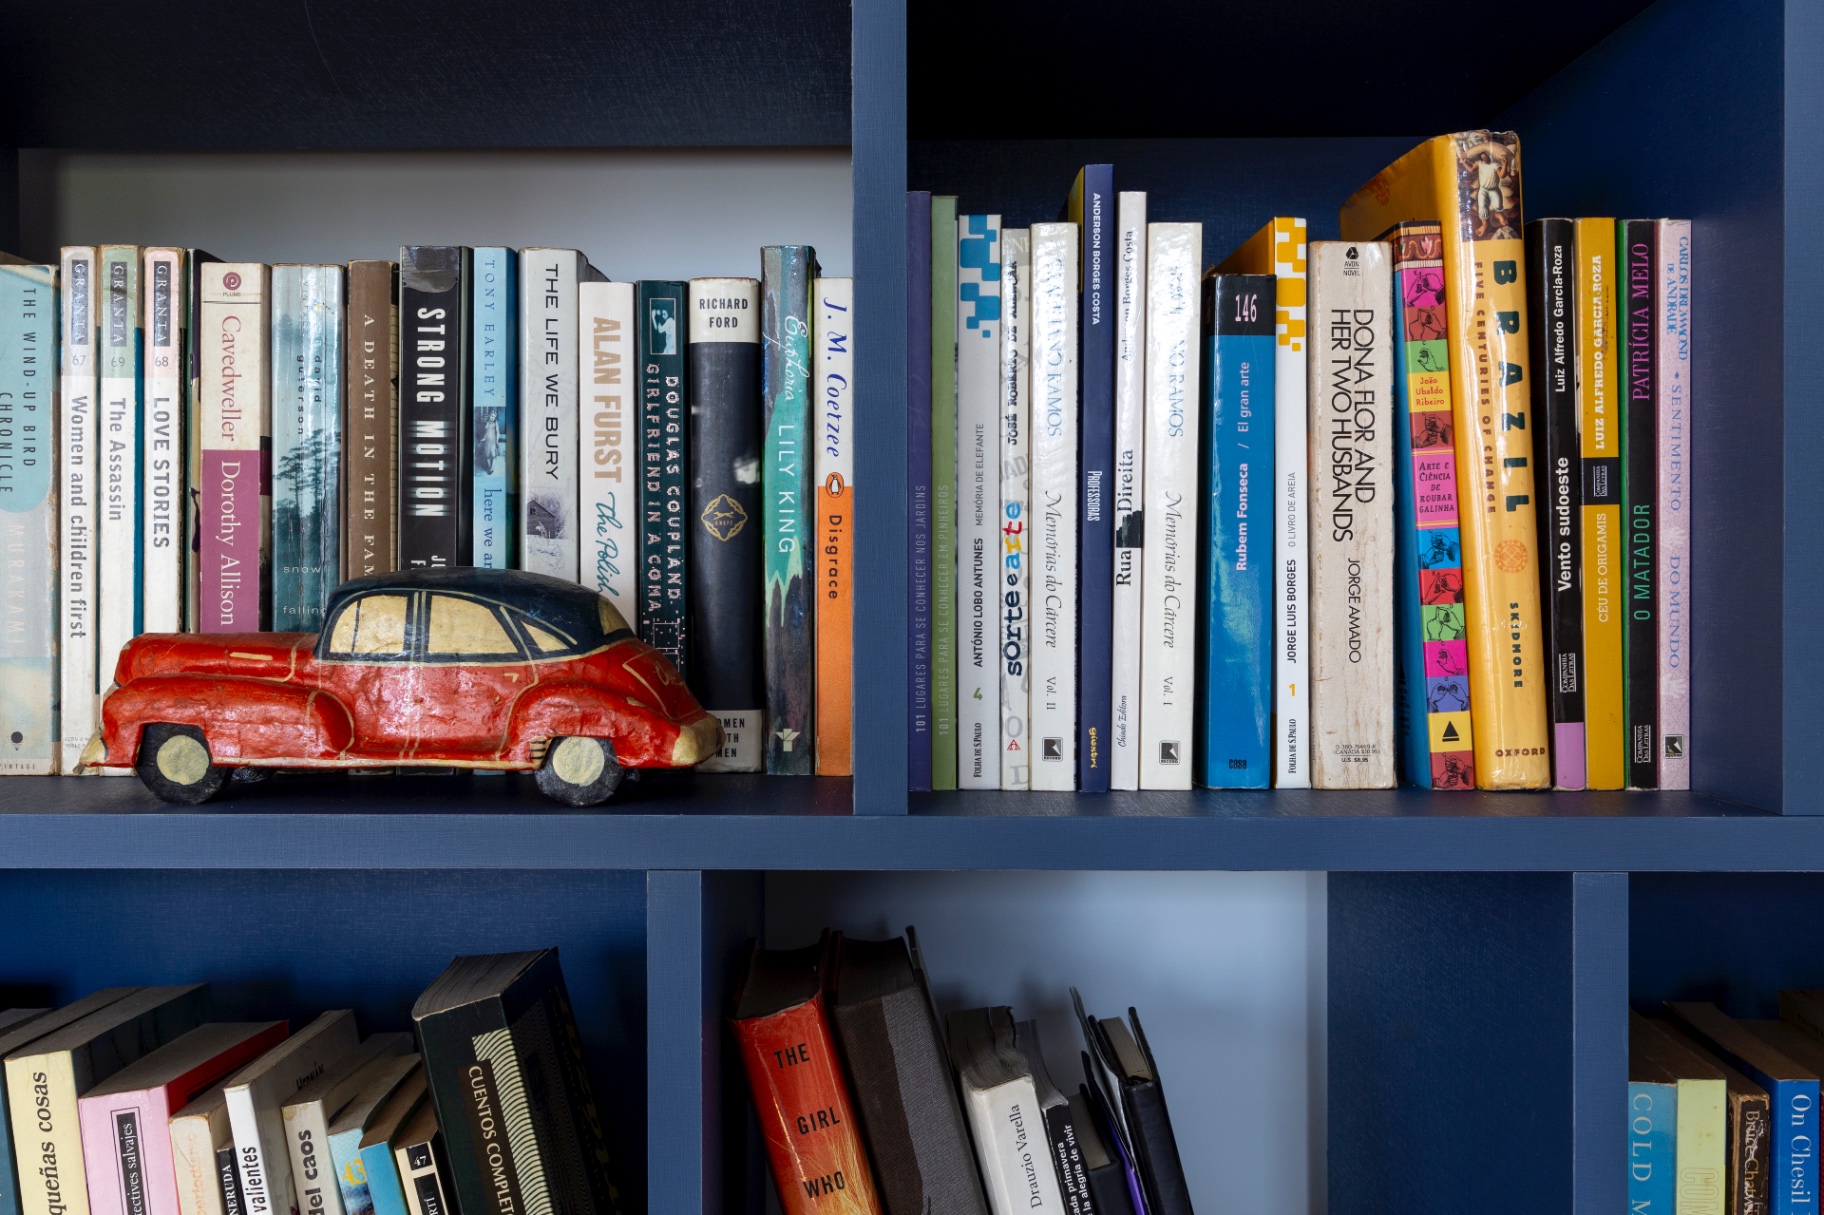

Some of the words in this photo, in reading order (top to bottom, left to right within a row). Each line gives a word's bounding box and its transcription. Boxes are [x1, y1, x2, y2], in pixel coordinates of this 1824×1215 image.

[1092, 193, 1101, 248] ANDERSON
[1092, 250, 1101, 290] BORGES
[1474, 262, 1486, 300] FIVE
[1553, 245, 1564, 318] Garcia-Roza
[1631, 243, 1649, 298] MELO
[1679, 236, 1688, 284] CARLOS
[23, 288, 36, 319] THE
[74, 263, 86, 341] GRANTA
[113, 265, 124, 343] GRANTA
[156, 265, 168, 343] GRANTA
[484, 260, 495, 310] TONY
[546, 264, 559, 309] THE
[700, 298, 748, 310] RICHARD
[824, 297, 847, 320] J.
[1092, 292, 1101, 325] COSTA
[1235, 294, 1258, 322] 146
[1592, 255, 1604, 348] GARCIA-ROZA
[364, 314, 375, 327] A
[546, 318, 559, 365] LIFE
[710, 317, 739, 328] FORD
[1332, 309, 1352, 351] HER
[1554, 321, 1565, 364] Alfredo
[1678, 286, 1688, 360] DRUMMOND
[154, 356, 169, 367] 68
[416, 307, 446, 403] STRONG
[484, 324, 495, 397] EARLEY
[593, 316, 622, 384] ALAN
[764, 314, 810, 401] Euphoria
[827, 330, 847, 360] M.
[1354, 309, 1376, 384] DONA
[1476, 309, 1491, 406] CENTURIES
[1628, 306, 1650, 401] PATRÍCIA
[23, 331, 36, 412] WIND-UP
[221, 316, 242, 442] Cavedweller
[314, 355, 322, 402] david
[364, 340, 375, 420] DEATH
[546, 374, 559, 408] WE
[1240, 362, 1250, 386] arte
[1332, 355, 1352, 413] TWO
[1493, 260, 1530, 512] BRAZIL
[1556, 368, 1566, 392] Luiz
[1594, 352, 1604, 414] ALFREDO
[109, 398, 126, 432] The
[153, 397, 170, 451] LOVE
[666, 376, 680, 475] DOUGLAS
[826, 373, 847, 458] Coetzee
[1238, 422, 1248, 432] El
[1240, 390, 1252, 418] gran
[1354, 390, 1376, 442] FLOR
[1482, 415, 1492, 436] OF
[0, 392, 13, 493] CHRONICLE
[23, 425, 36, 467] BIRD
[71, 396, 88, 466] Women
[364, 434, 375, 460] IN
[546, 416, 559, 480] BURY
[593, 395, 622, 482] FURST
[778, 424, 795, 477] LILY
[1596, 418, 1604, 450] LUIZ
[1671, 384, 1682, 512] SENTIMENTO
[71, 472, 88, 506] and
[109, 440, 126, 521] Assassin
[415, 420, 446, 517] MOTION
[1118, 449, 1133, 512] Direita
[1236, 462, 1248, 518] Fonseca
[1332, 418, 1353, 542] HUSBANDS
[1354, 448, 1376, 504] AND
[1419, 472, 1451, 482] CIÊNCIA
[1482, 445, 1496, 514] CHANGE
[153, 458, 170, 548] STORIES
[216, 460, 241, 546] Dorothy
[364, 473, 375, 520] THE
[484, 488, 502, 522] here
[594, 492, 624, 537] The
[914, 485, 926, 527] JARDINS
[1086, 470, 1103, 522] PROFESSORAS
[1418, 504, 1454, 514] GALINHA
[1420, 494, 1453, 503] ROUBAR
[1556, 457, 1571, 536] sudoeste
[484, 527, 493, 547] we
[666, 485, 682, 600] COUPLAND
[778, 491, 796, 553] KING
[914, 534, 926, 553] NOS
[1046, 490, 1064, 571] Memórias
[1236, 522, 1248, 570] Rubem
[1598, 513, 1608, 576] ORIGAMIS
[71, 514, 88, 592] children
[283, 566, 322, 574] snow
[593, 538, 621, 595] Polish
[825, 514, 843, 600] Disgrace
[973, 538, 984, 588] ANTUNES
[1116, 550, 1132, 586] Rua
[1558, 542, 1572, 592] Vento
[1633, 504, 1650, 600] MATADOR
[1669, 555, 1682, 585] DO
[8, 524, 24, 644] MURAKAMI
[220, 553, 241, 626] Allison
[914, 558, 926, 612] CONHECER
[973, 590, 983, 618] LOBO
[1046, 574, 1064, 592] do
[1287, 559, 1297, 602] BORGES
[1348, 558, 1362, 604] JORGE
[1598, 578, 1608, 594] DE
[71, 598, 87, 638] first
[914, 617, 926, 629] SE
[1046, 594, 1064, 648] Cárcere
[1287, 604, 1297, 628] LUIS
[1598, 597, 1609, 622] CÉU
[1634, 610, 1650, 620] O
[1669, 590, 1682, 669] MUNDO
[914, 633, 926, 659] PARA
[970, 620, 983, 668] ANTÓNIO
[1287, 630, 1297, 664] JORGE
[1348, 605, 1362, 664] AMADO
[1509, 602, 1523, 688] SKIDMORE
[914, 664, 926, 709] LUGARES
[914, 714, 926, 732] 101
[1088, 726, 1098, 769] giostri
[1495, 747, 1546, 758] OXFORD
[773, 1042, 810, 1069] THE
[32, 1070, 53, 1132] cosas
[796, 1106, 840, 1135] GIRL
[1791, 1094, 1812, 1127] On
[118, 1122, 142, 1170] salvajes
[468, 1065, 497, 1140] CUENTOS
[486, 1142, 516, 1215] COMPLET
[1010, 1104, 1028, 1152] Varella
[1064, 1124, 1075, 1146] vivir
[1631, 1092, 1653, 1182] COLD
[1745, 1110, 1760, 1158] Bruce
[298, 1129, 318, 1180] caos
[342, 1158, 367, 1187] 43
[414, 1155, 427, 1167] 47
[1058, 1142, 1078, 1193] primavera
[1070, 1148, 1080, 1161] de
[1791, 1135, 1812, 1205] Chesil
[221, 1164, 243, 1215] NERUDA
[242, 1146, 268, 1212] valientes
[802, 1170, 846, 1199] WHO
[1022, 1152, 1042, 1210] Drauzio
[1073, 1164, 1088, 1198] alegría
[1082, 1201, 1092, 1212] la
